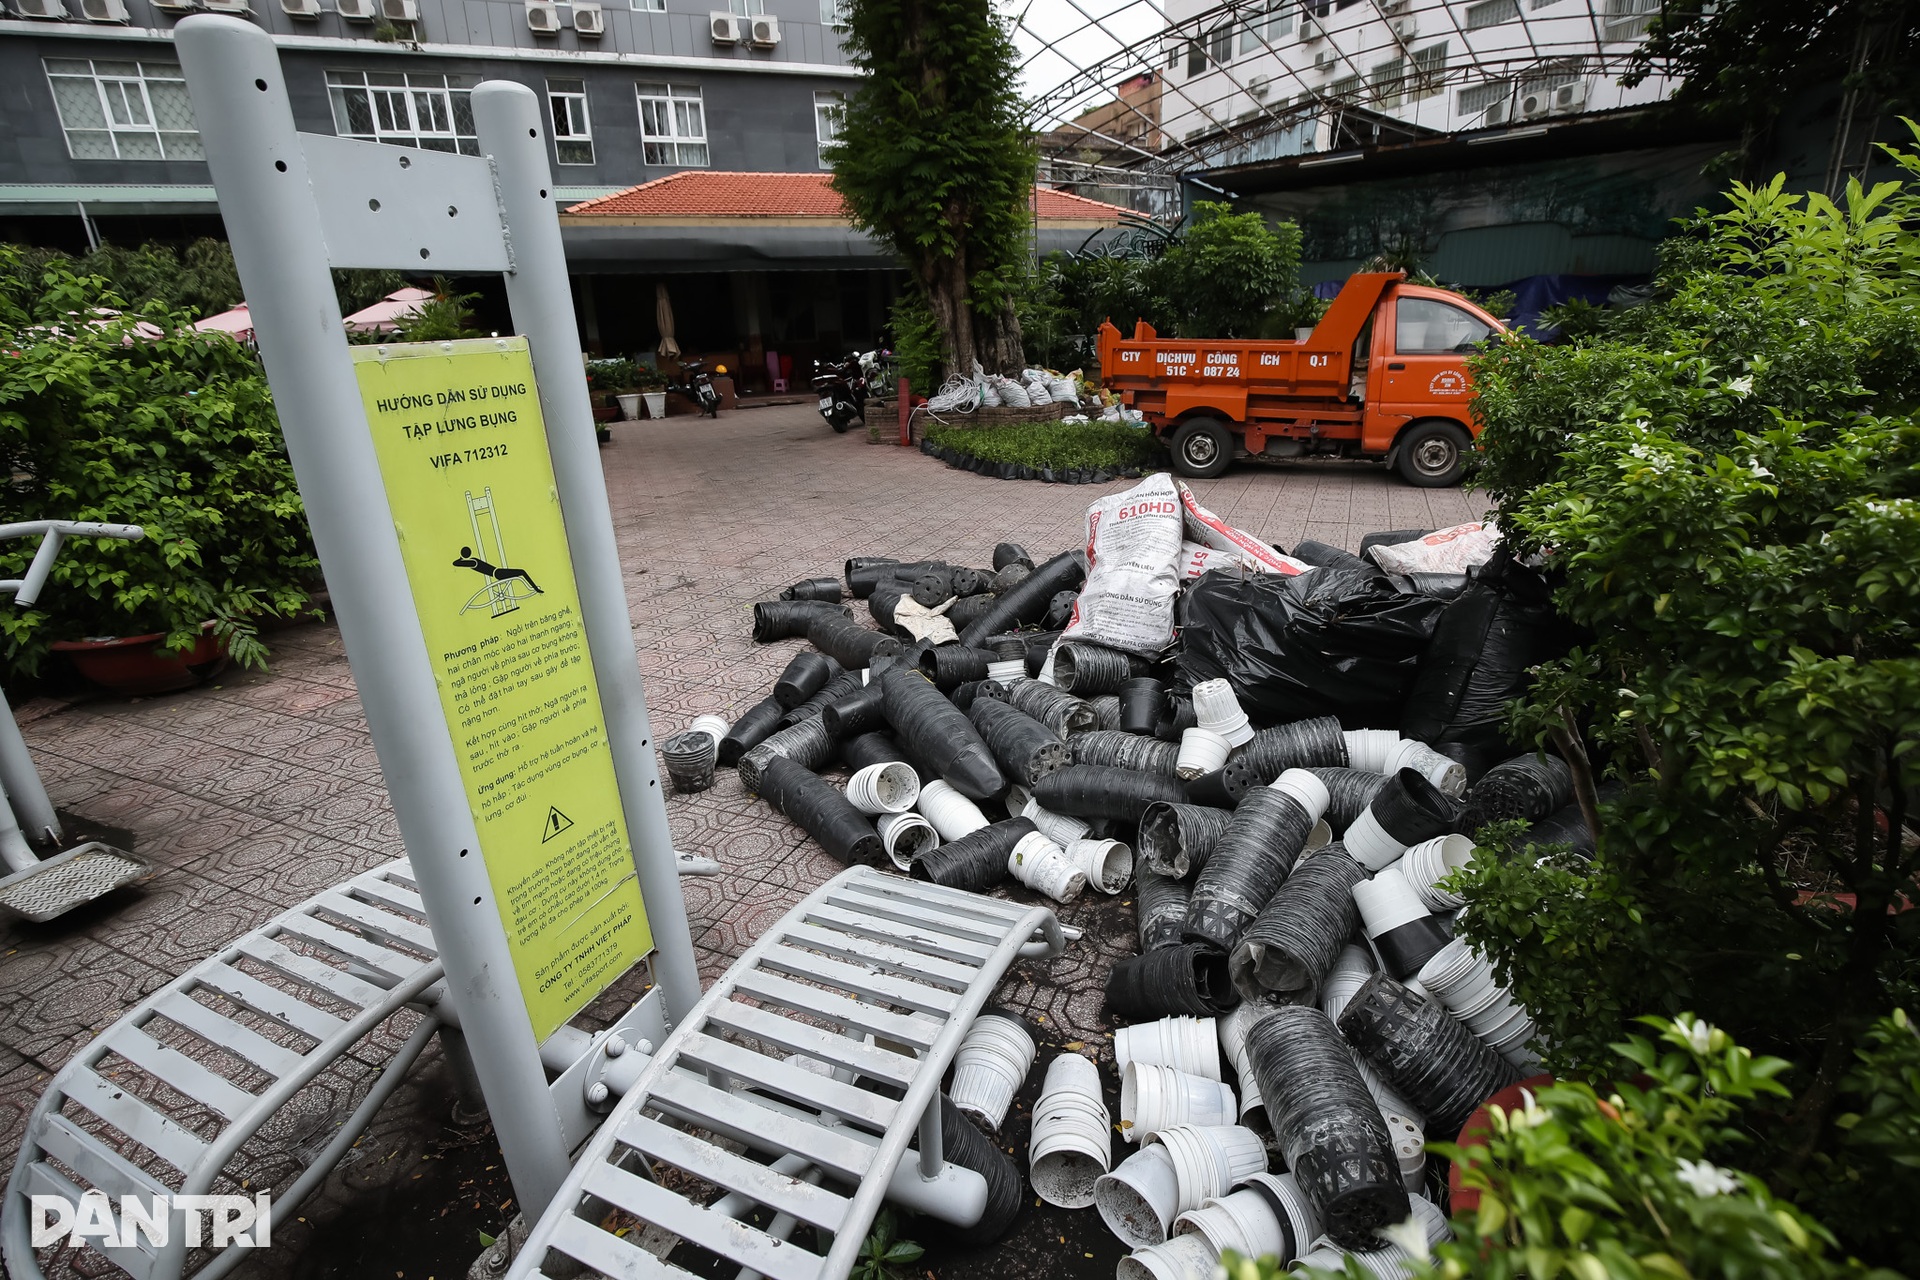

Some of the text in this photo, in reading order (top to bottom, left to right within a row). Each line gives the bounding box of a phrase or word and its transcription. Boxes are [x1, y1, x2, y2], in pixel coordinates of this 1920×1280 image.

[1121, 351, 1140, 362] CTY
[1206, 351, 1237, 364] CÔNG
[1260, 352, 1280, 366] ÍCH
[1309, 354, 1328, 368] Q.1
[1166, 366, 1187, 376] 51C
[377, 383, 526, 413] HƯỚNG DẪN SỬ DỤNG
[402, 411, 517, 440] TẬP LƯNG BỤNG
[430, 444, 508, 468] VIFA 712312
[1119, 501, 1176, 520] 610HD
